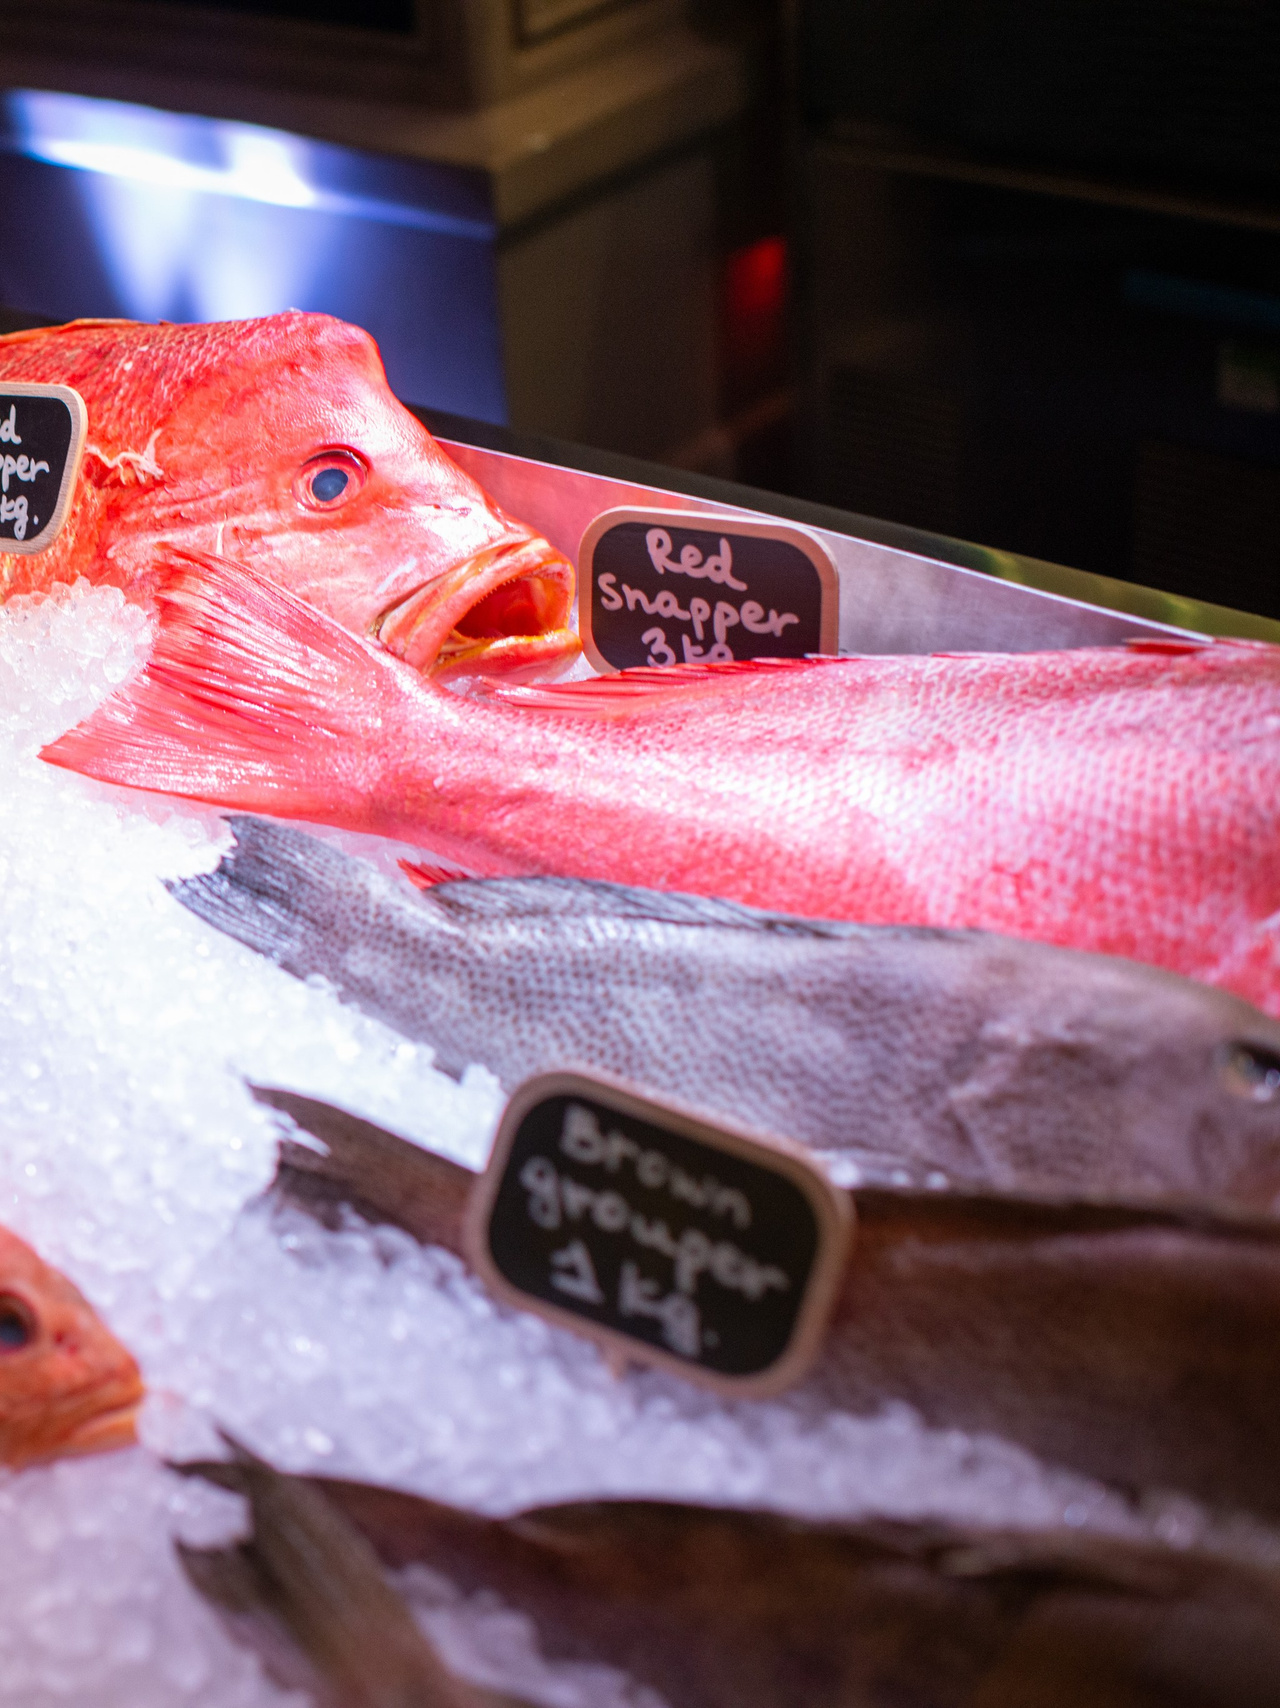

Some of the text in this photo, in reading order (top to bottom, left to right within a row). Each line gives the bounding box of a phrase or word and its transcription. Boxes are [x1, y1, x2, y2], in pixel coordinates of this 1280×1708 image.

[0, 494, 39, 541] kg.
[645, 527, 748, 592] Red
[597, 572, 800, 644] snapper
[641, 627, 677, 667] 3
[560, 1101, 753, 1230] Brown
[520, 1155, 791, 1300] grouper
[549, 1238, 719, 1357] 1 kg.
